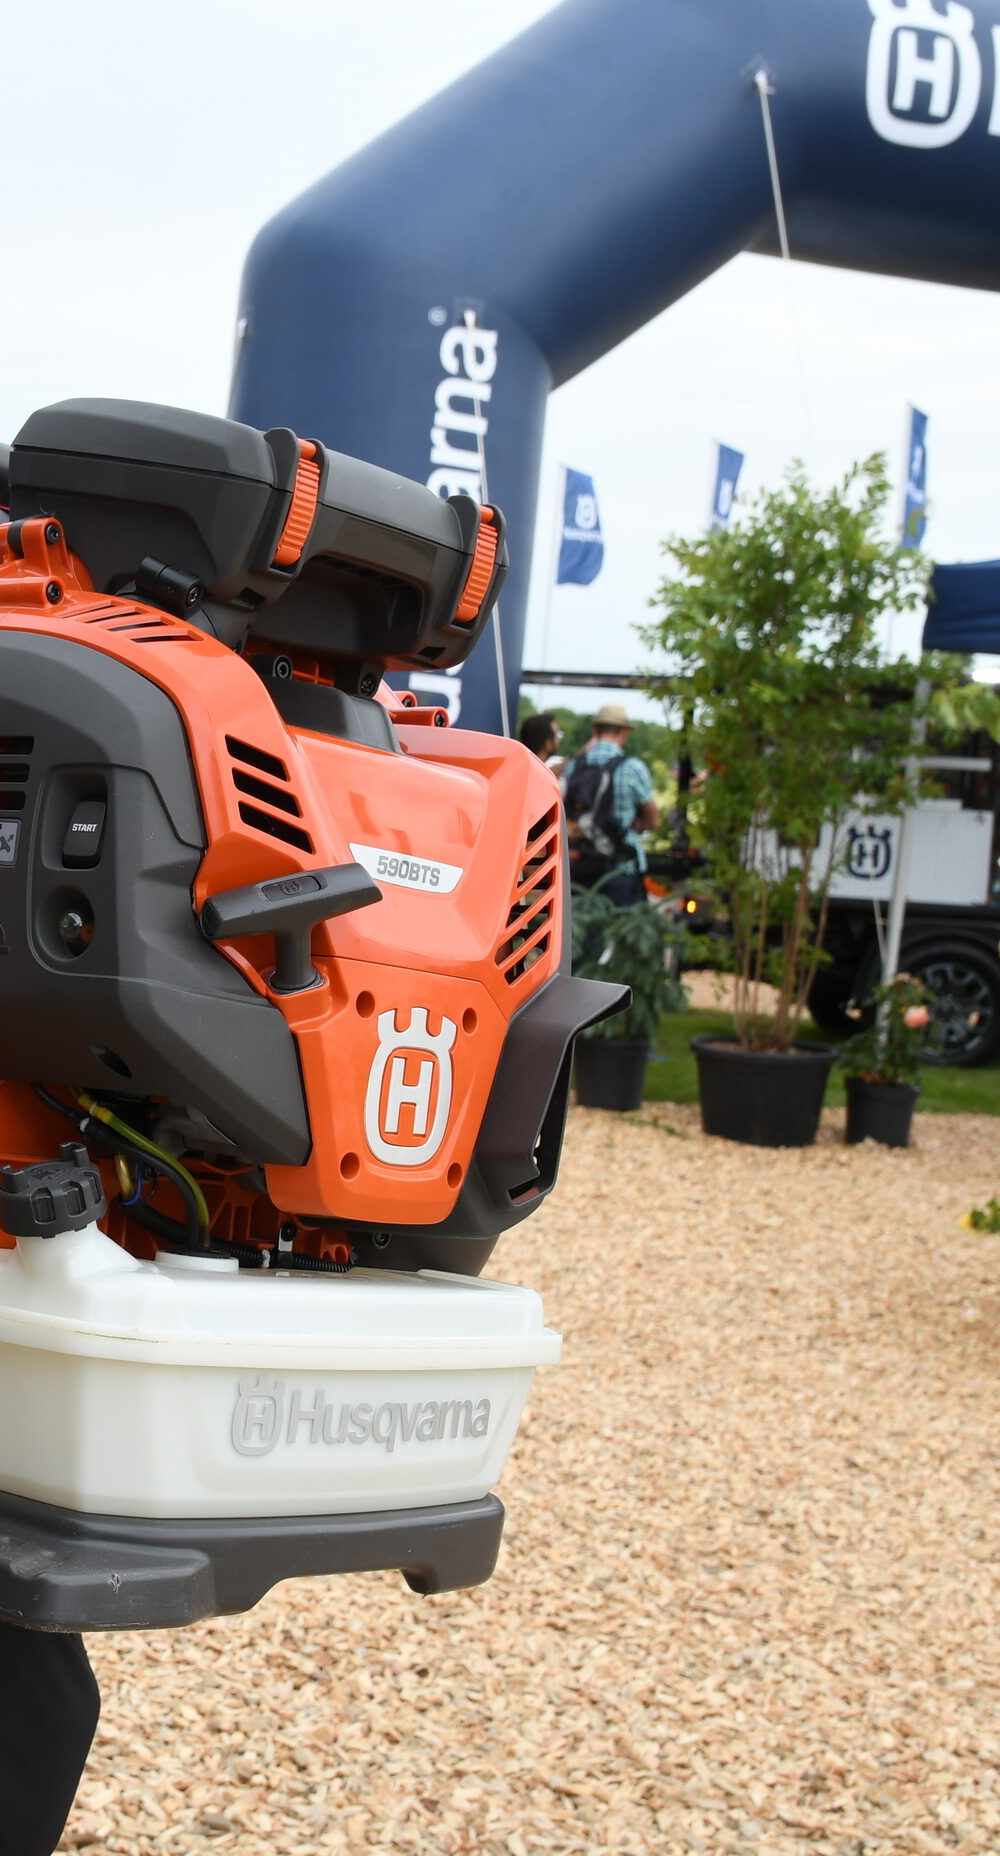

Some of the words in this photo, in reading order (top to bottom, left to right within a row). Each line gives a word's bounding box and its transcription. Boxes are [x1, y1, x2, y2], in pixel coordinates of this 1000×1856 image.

[72, 823, 98, 832] START
[376, 855, 441, 887] 590BTS
[286, 1389, 492, 1453] Husqvarna
